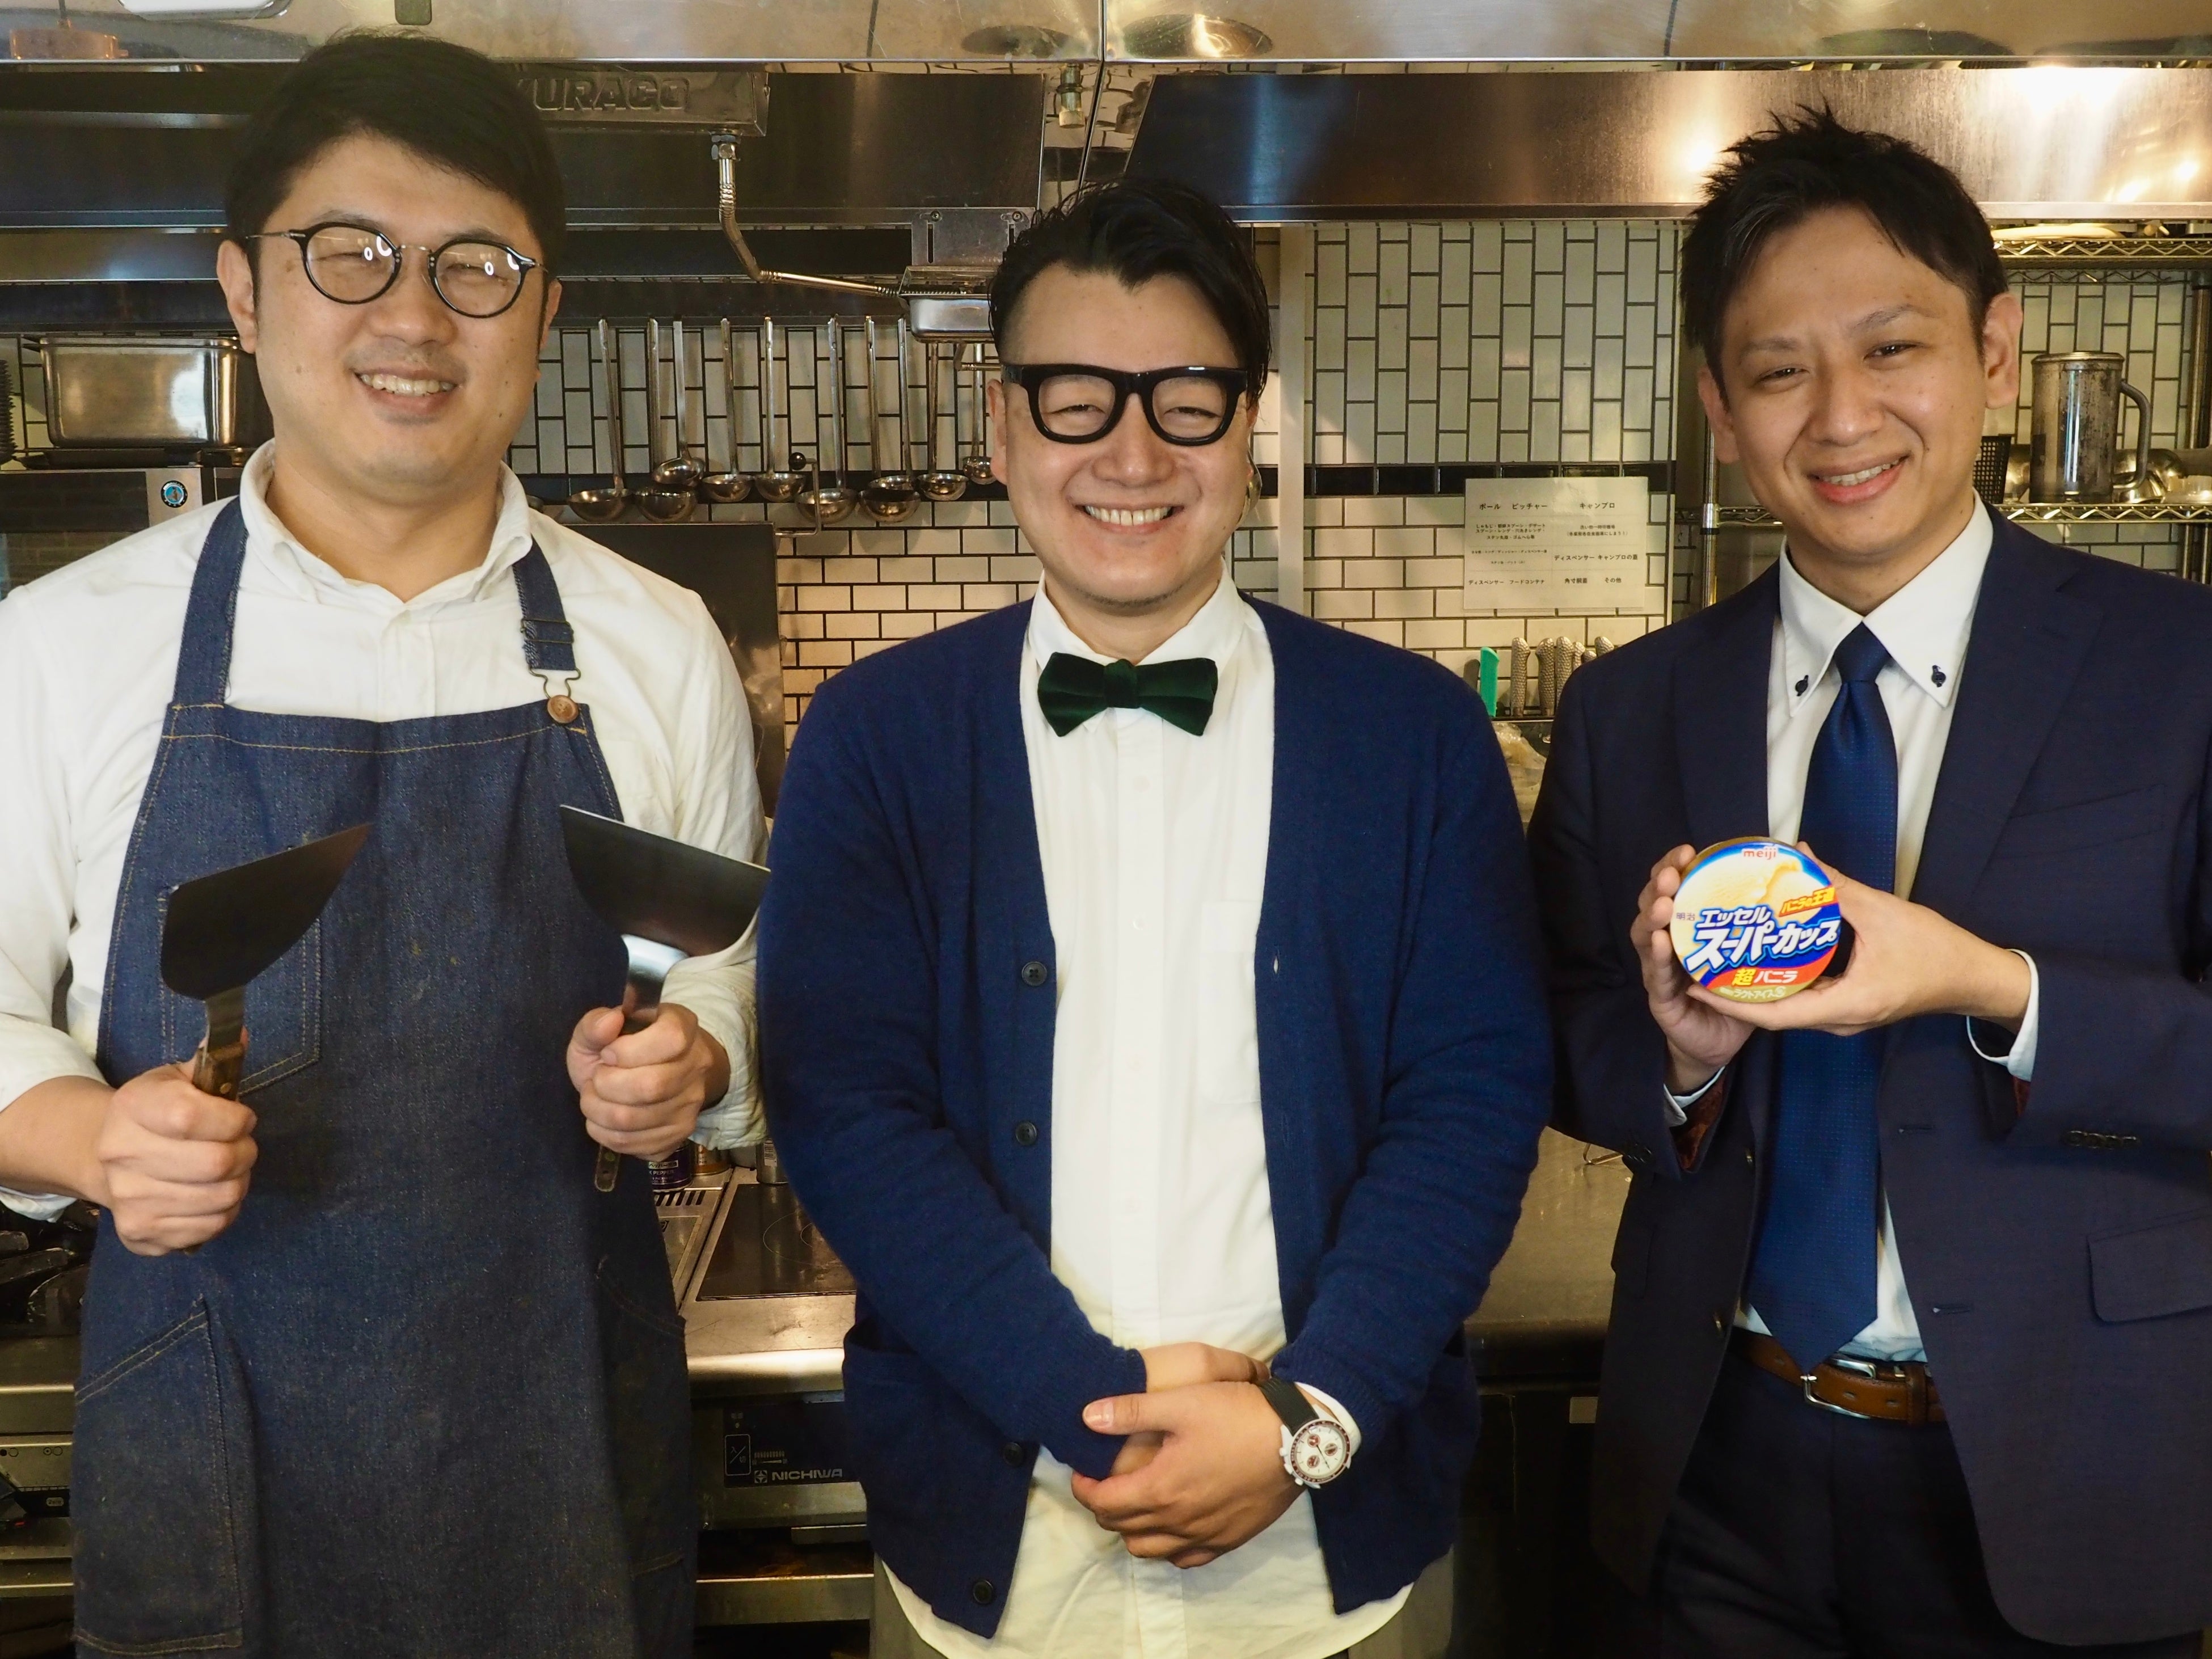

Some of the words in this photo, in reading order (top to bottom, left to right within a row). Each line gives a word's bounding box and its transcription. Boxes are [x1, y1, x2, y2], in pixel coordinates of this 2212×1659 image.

[517, 78, 690, 111] URACO
[1743, 846, 1777, 860] meiji
[1677, 912, 1695, 921] 明治
[1696, 906, 1771, 928] エッセル
[1686, 919, 1840, 972] スーパーカップ
[771, 1468, 843, 1481] NICHIWA
